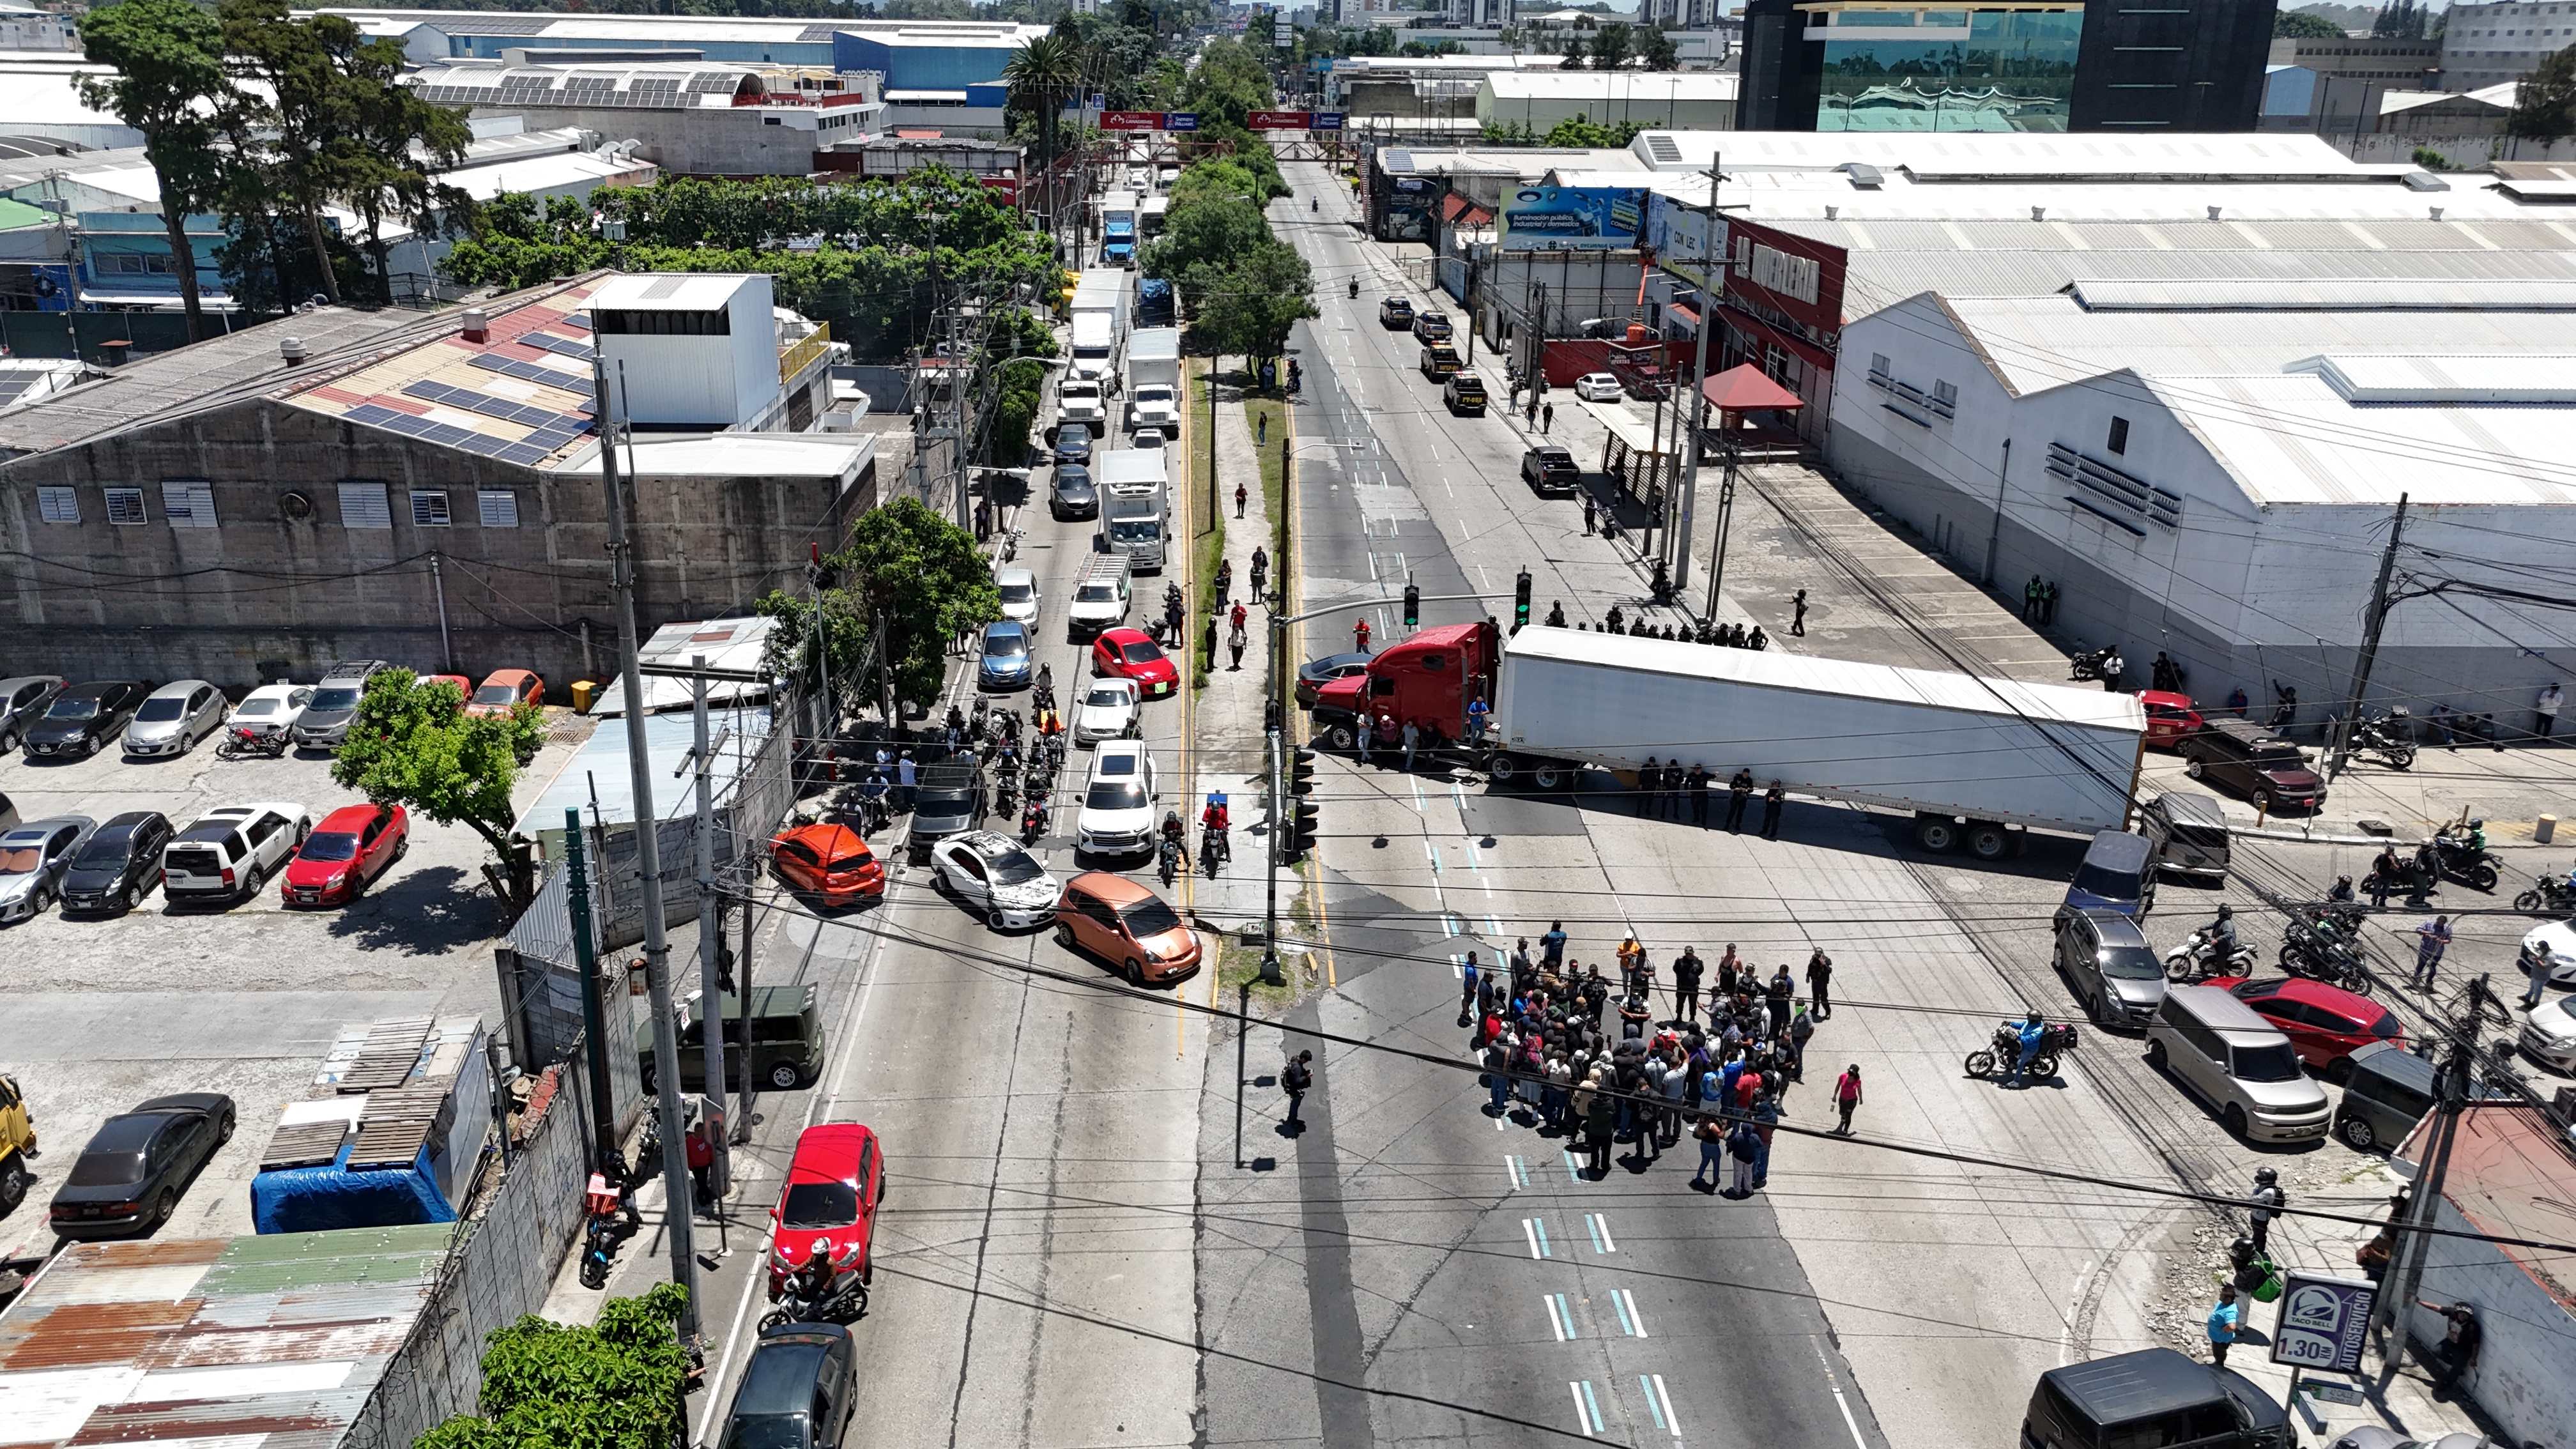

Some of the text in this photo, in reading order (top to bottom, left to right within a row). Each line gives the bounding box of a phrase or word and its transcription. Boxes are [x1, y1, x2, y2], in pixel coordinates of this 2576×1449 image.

[2278, 1337, 2333, 1360] 1.30 KM
[2340, 1292, 2372, 1371] AUTOSERVICIO
